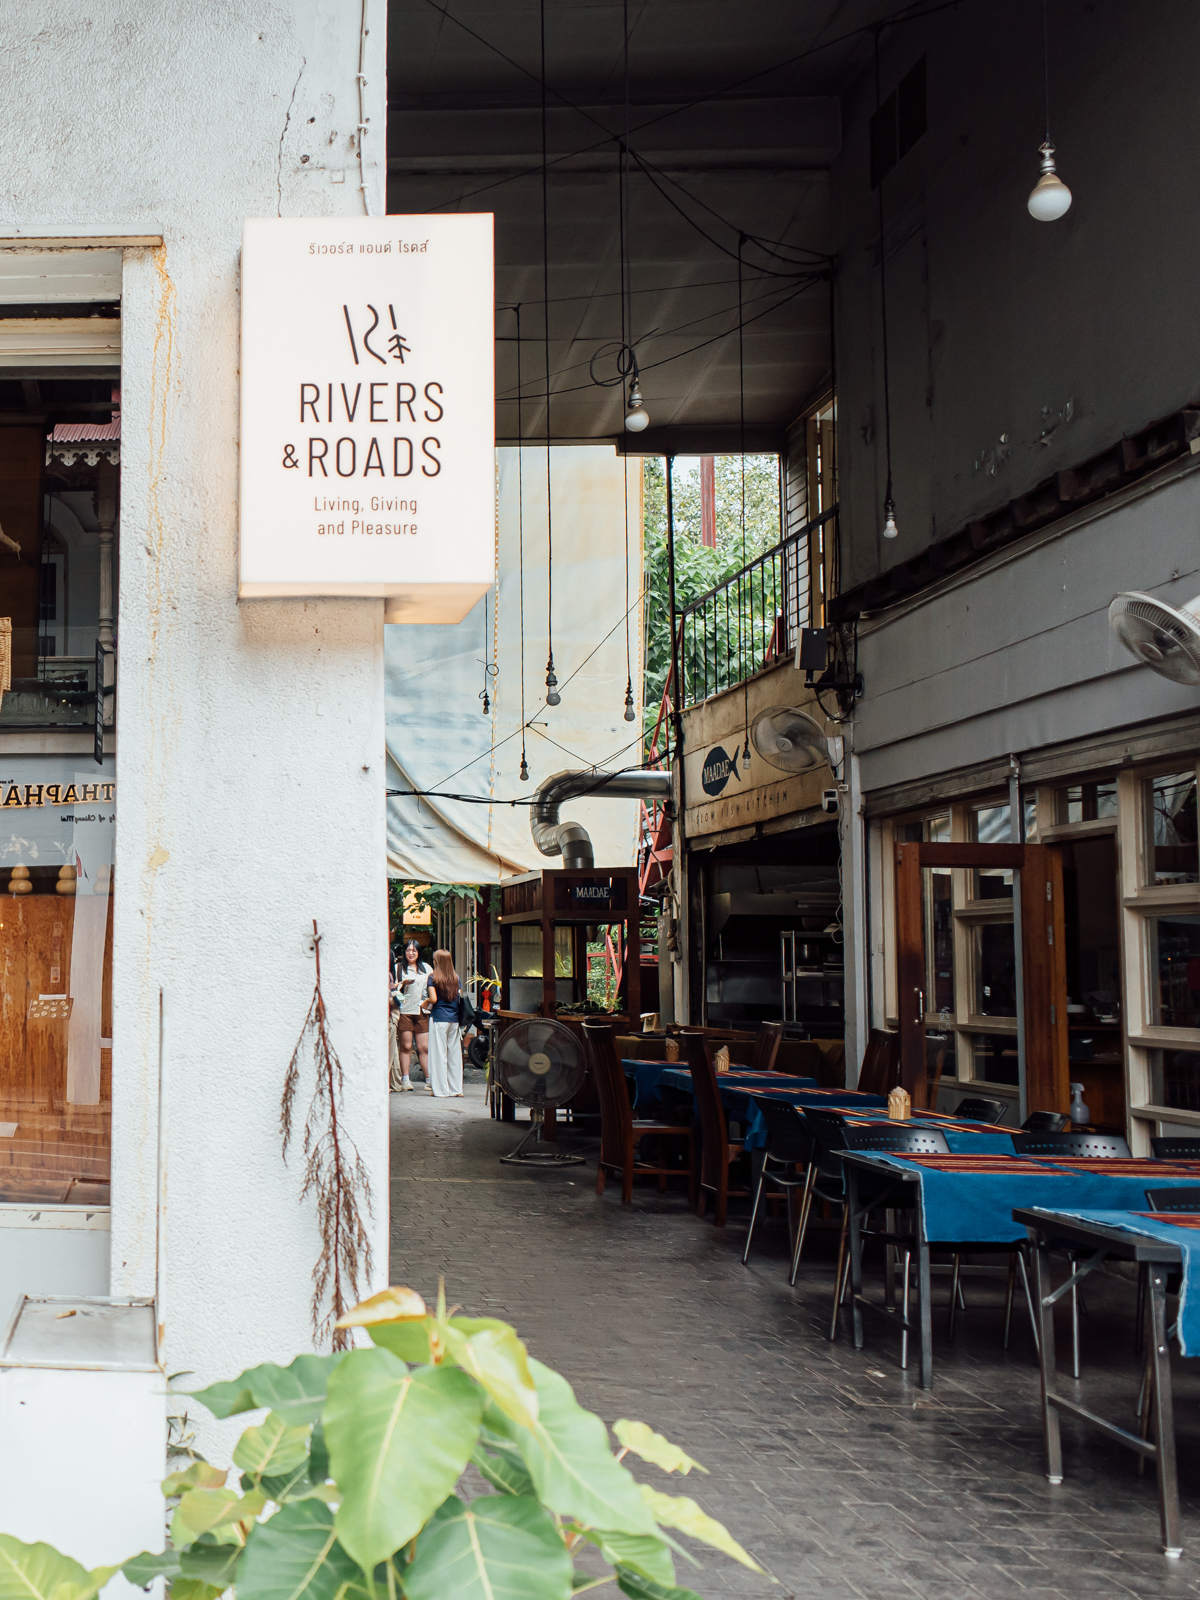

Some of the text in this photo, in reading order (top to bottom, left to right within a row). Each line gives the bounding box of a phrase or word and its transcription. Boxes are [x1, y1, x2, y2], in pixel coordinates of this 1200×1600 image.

[360, 240, 392, 254] แอนด์
[398, 239, 430, 253] โรดส์
[300, 381, 444, 423] RIVERS
[314, 496, 418, 515] Living, Giving
[318, 520, 418, 536] and Pleasure
[704, 759, 730, 785] MAADAE
[746, 790, 788, 810] KITCHEN
[576, 886, 610, 898] MAADAE
